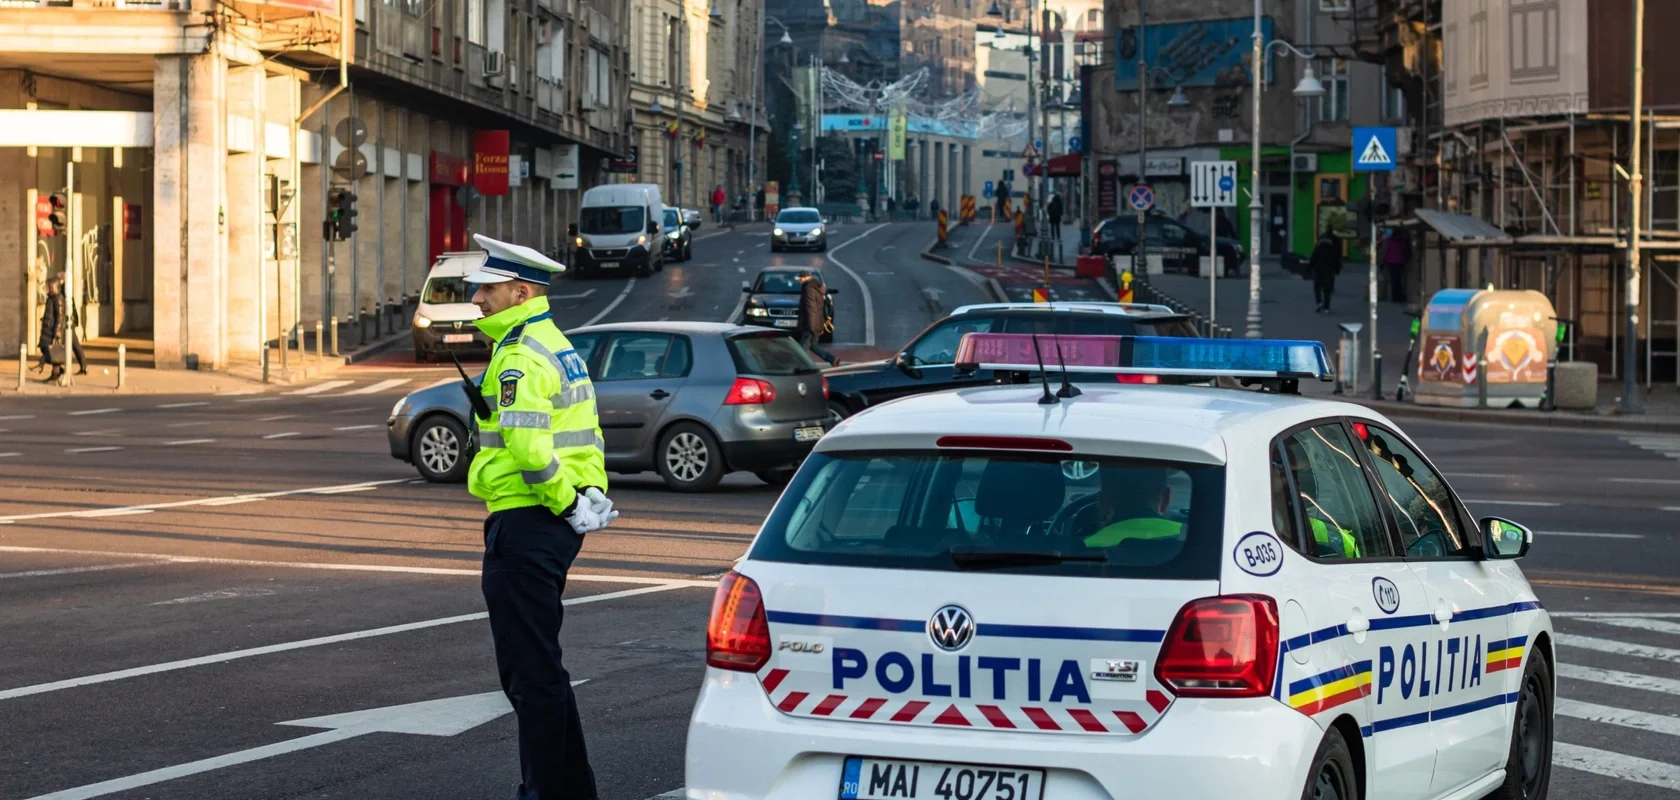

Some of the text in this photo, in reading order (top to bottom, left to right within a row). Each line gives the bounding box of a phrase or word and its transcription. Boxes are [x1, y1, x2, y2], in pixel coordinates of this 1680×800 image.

[475, 152, 508, 164] Forza
[476, 163, 508, 174] Rossa
[1244, 542, 1277, 568] B-035
[1384, 586, 1397, 606] 112
[778, 640, 825, 654] POLO
[832, 647, 1092, 704] POLITIA
[1105, 660, 1139, 673] TSI
[1377, 633, 1481, 705] POLITIA
[843, 762, 1030, 800] RO MAI 40751
